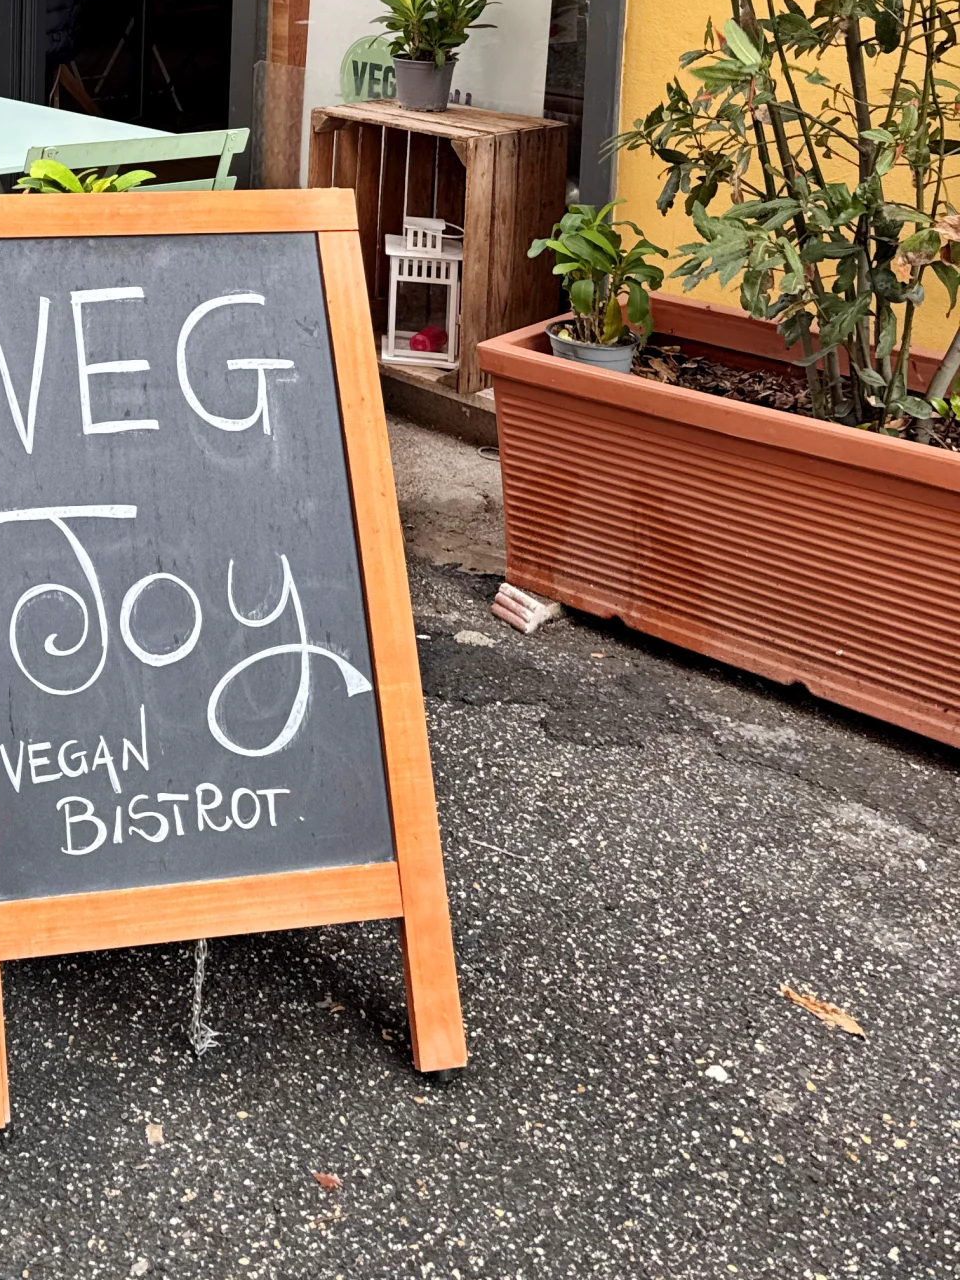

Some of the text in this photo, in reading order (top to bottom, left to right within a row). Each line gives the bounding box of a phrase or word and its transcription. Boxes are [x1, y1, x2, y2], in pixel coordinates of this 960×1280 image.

[356, 42, 386, 54] URBA
[352, 60, 397, 99] VEG
[0, 703, 150, 794] VEGAN
